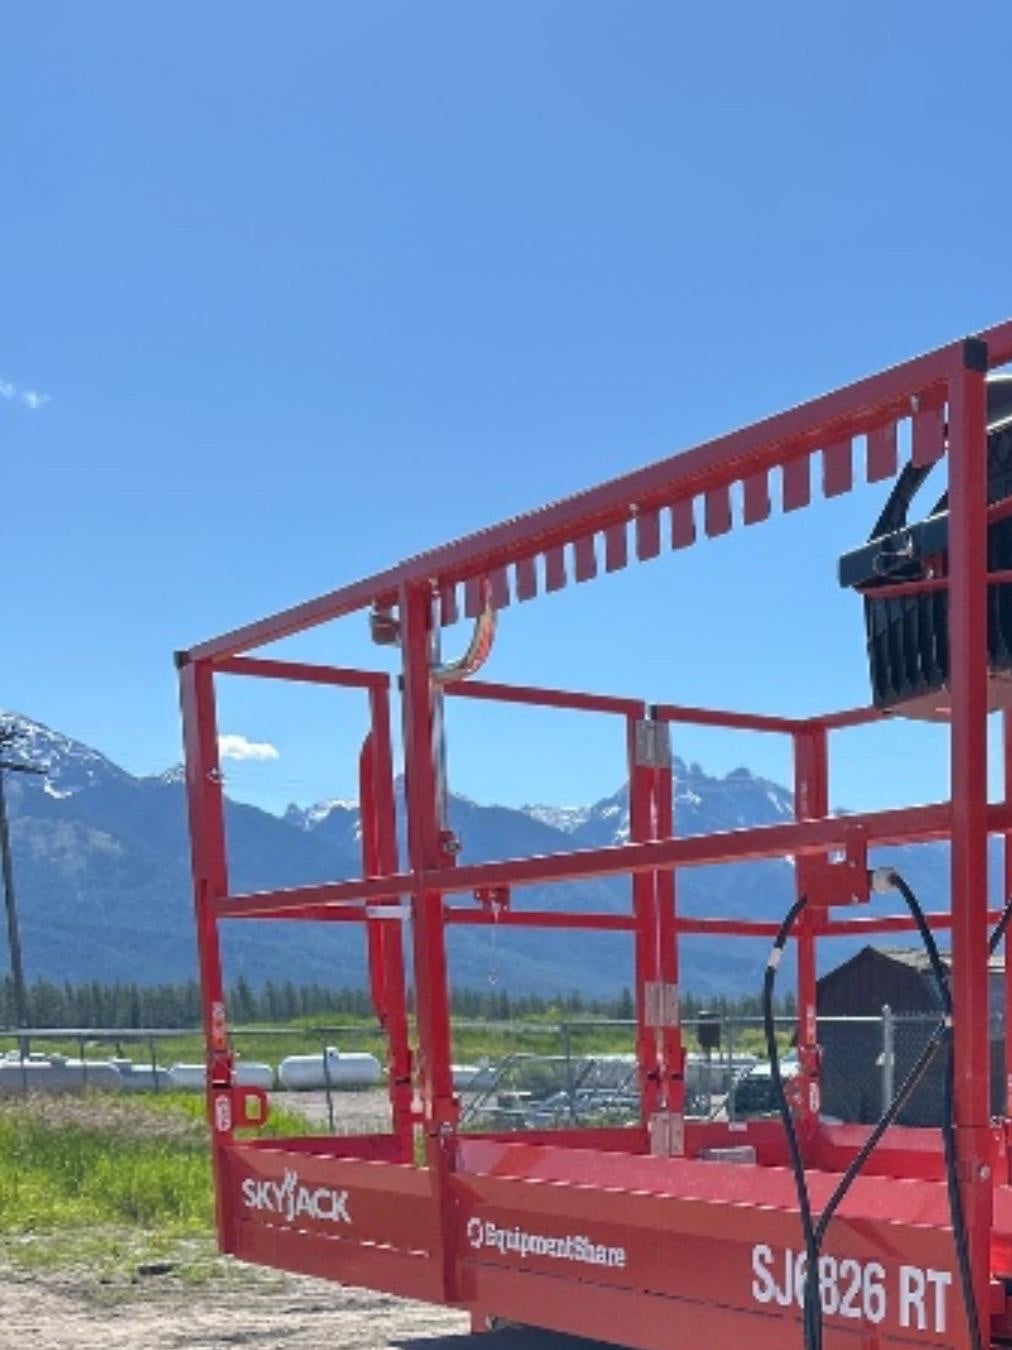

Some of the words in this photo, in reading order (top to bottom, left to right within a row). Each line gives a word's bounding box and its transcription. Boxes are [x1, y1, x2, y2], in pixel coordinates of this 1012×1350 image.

[241, 1168, 352, 1223] SKYJACK
[484, 1221, 626, 1268] EquipmentShare
[899, 1264, 953, 1334] RT
